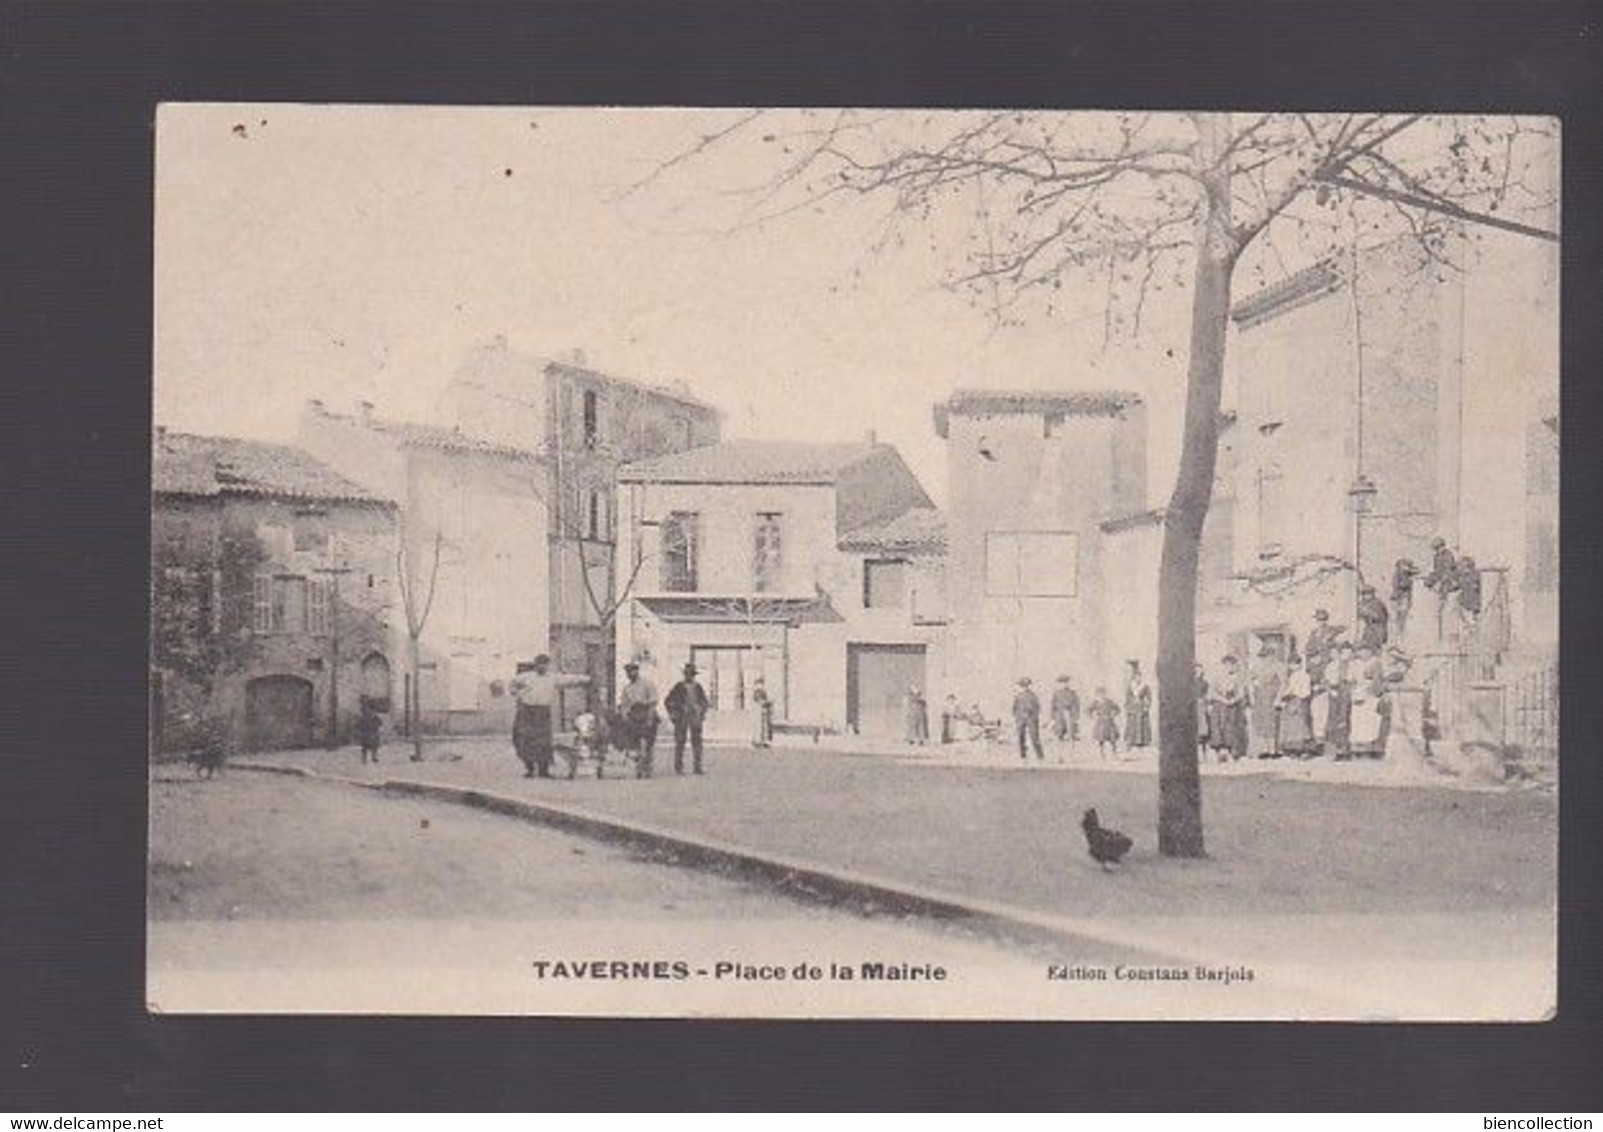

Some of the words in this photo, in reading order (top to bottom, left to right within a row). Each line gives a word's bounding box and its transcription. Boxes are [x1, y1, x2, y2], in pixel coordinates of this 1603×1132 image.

[533, 961, 690, 980] TAVERNES
[714, 962, 786, 981] Place
[792, 963, 823, 981] de
[830, 964, 853, 981] la
[861, 964, 948, 982] Mairie
